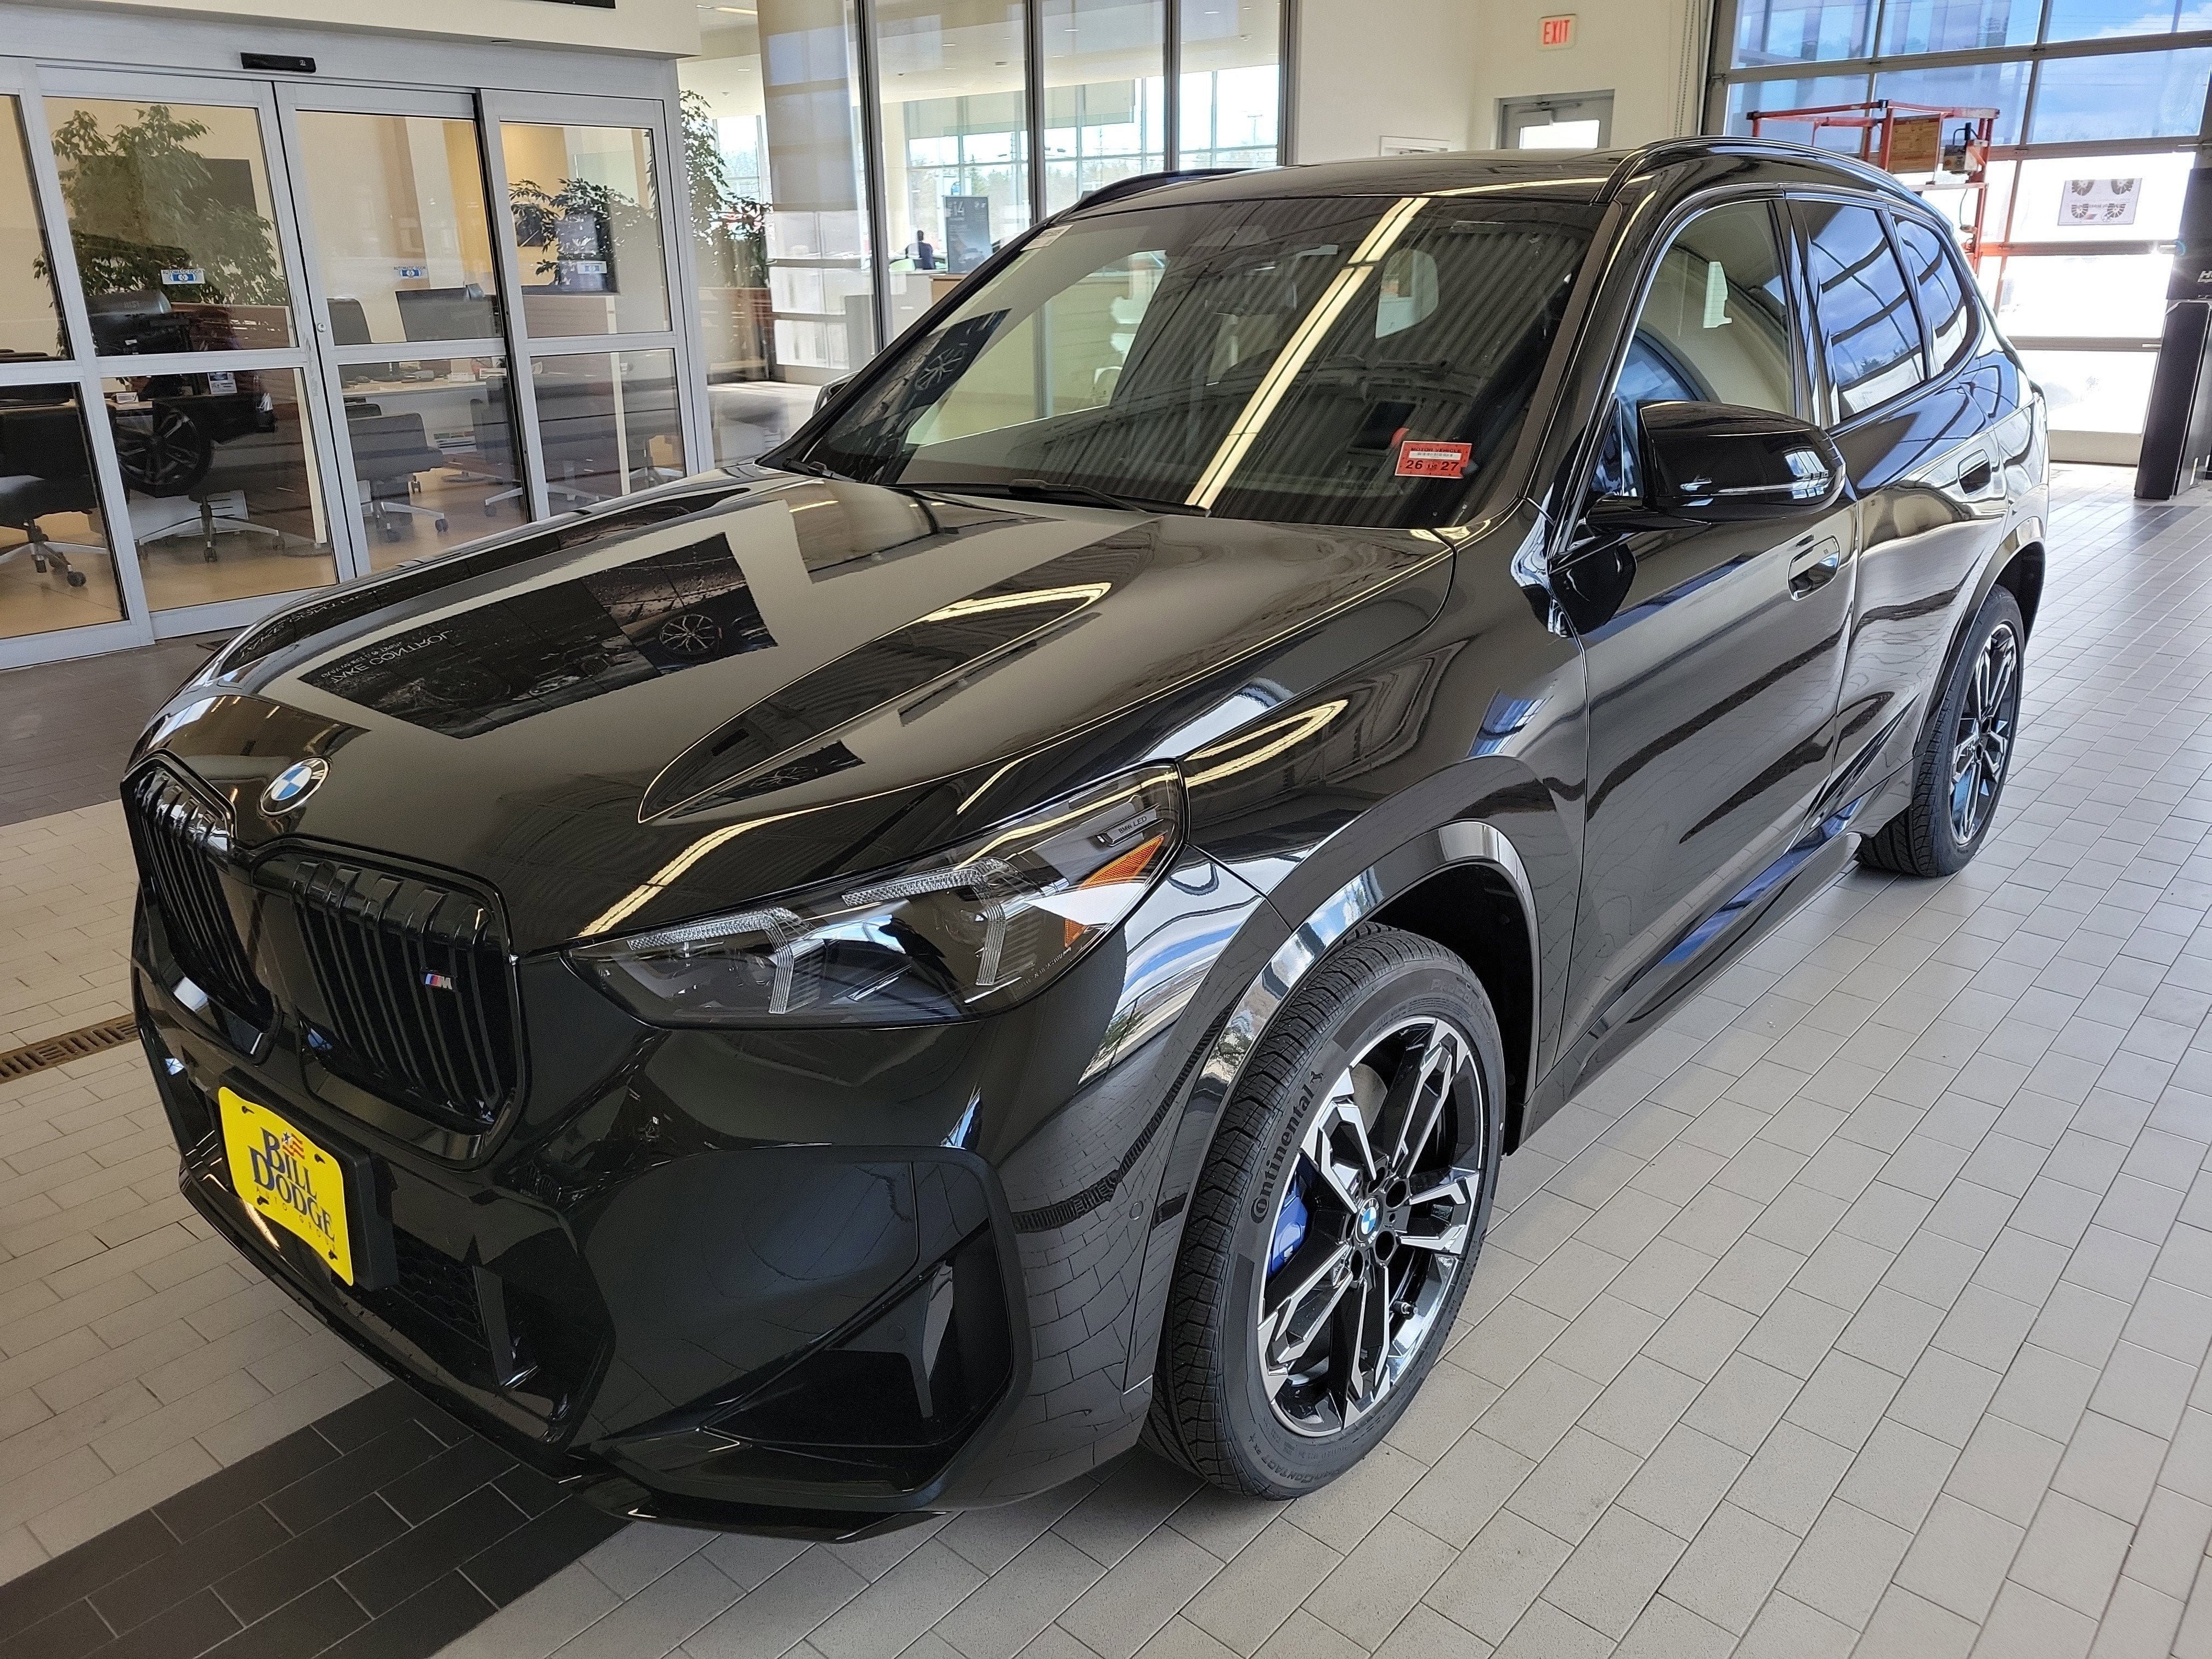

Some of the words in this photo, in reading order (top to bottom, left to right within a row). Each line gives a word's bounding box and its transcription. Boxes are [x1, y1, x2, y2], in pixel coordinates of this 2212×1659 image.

[1543, 20, 1570, 44] EXIT
[1405, 460, 1424, 469] 26
[1440, 461, 1460, 471] 27
[1118, 823, 1132, 833] BMW
[1133, 816, 1147, 827] LED
[260, 1126, 317, 1201] BILL
[1250, 1084, 1314, 1224] Continental
[248, 1145, 335, 1243] DODGE
[256, 1186, 287, 1211] AUTO
